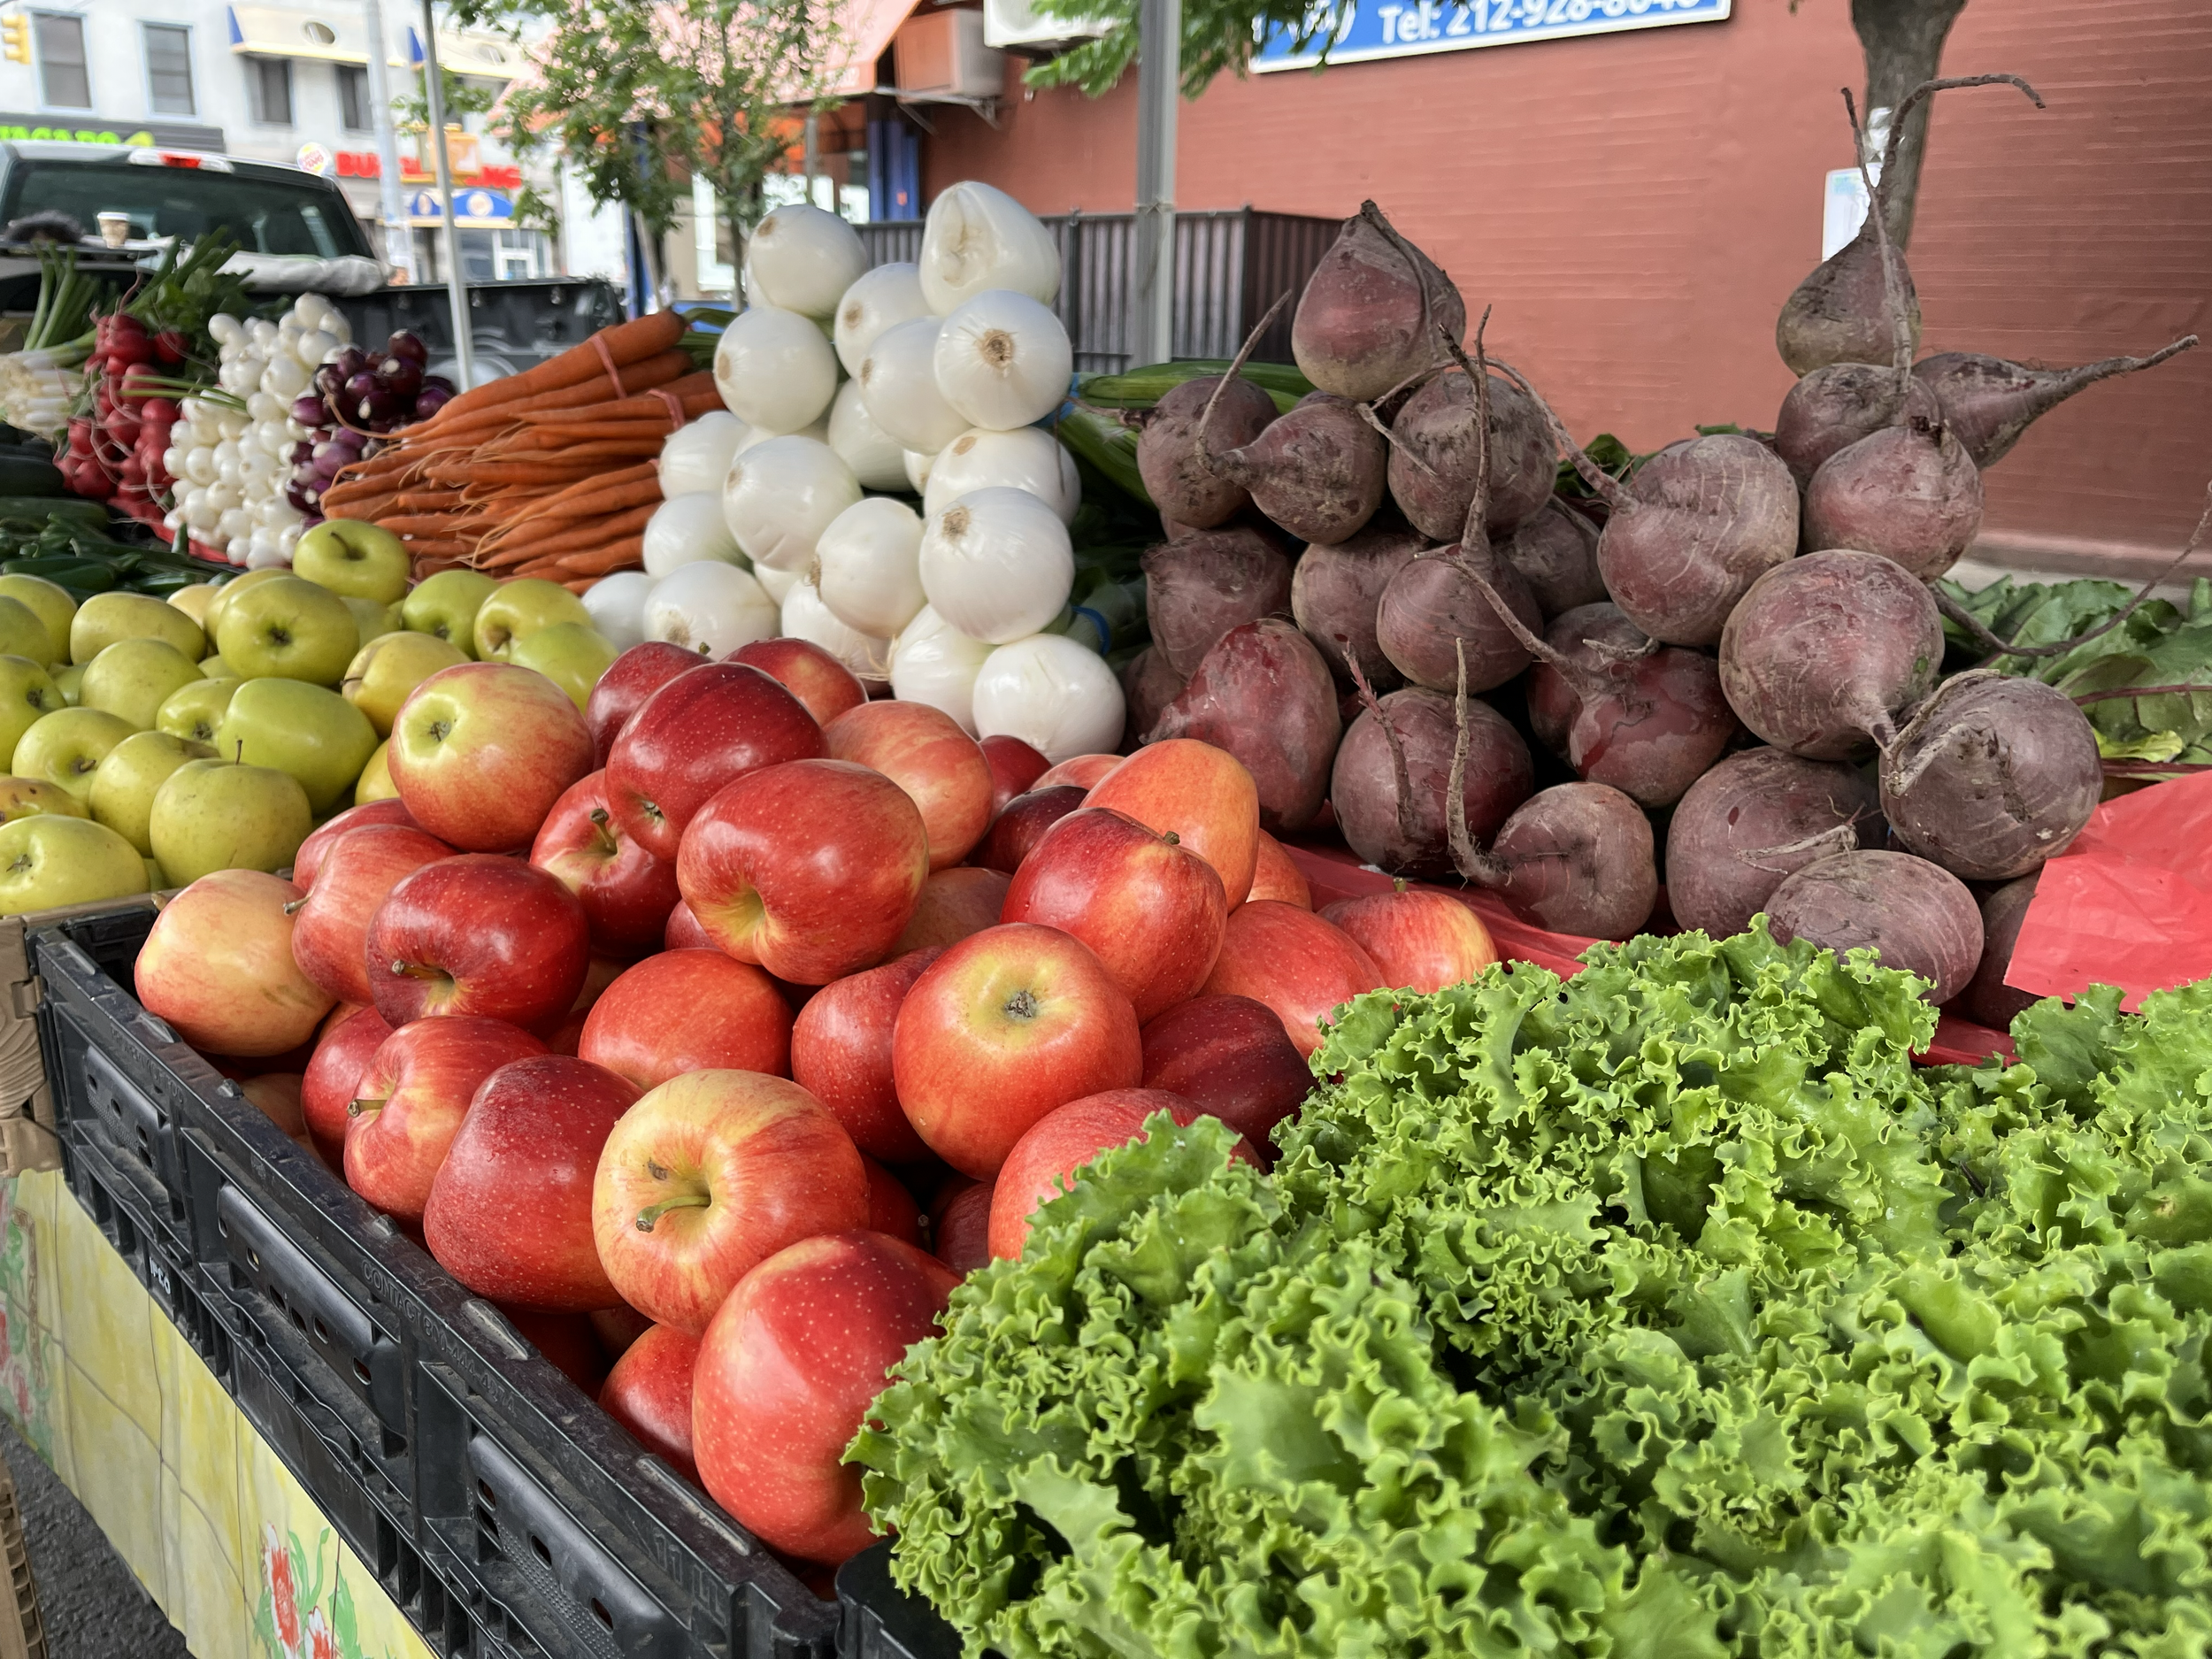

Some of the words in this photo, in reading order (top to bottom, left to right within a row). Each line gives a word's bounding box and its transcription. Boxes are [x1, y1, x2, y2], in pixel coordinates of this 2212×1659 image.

[1378, 4, 1442, 44] Tel:
[1445, 0, 1701, 37] 212-928-
[361, 1258, 422, 1327] CONTACT
